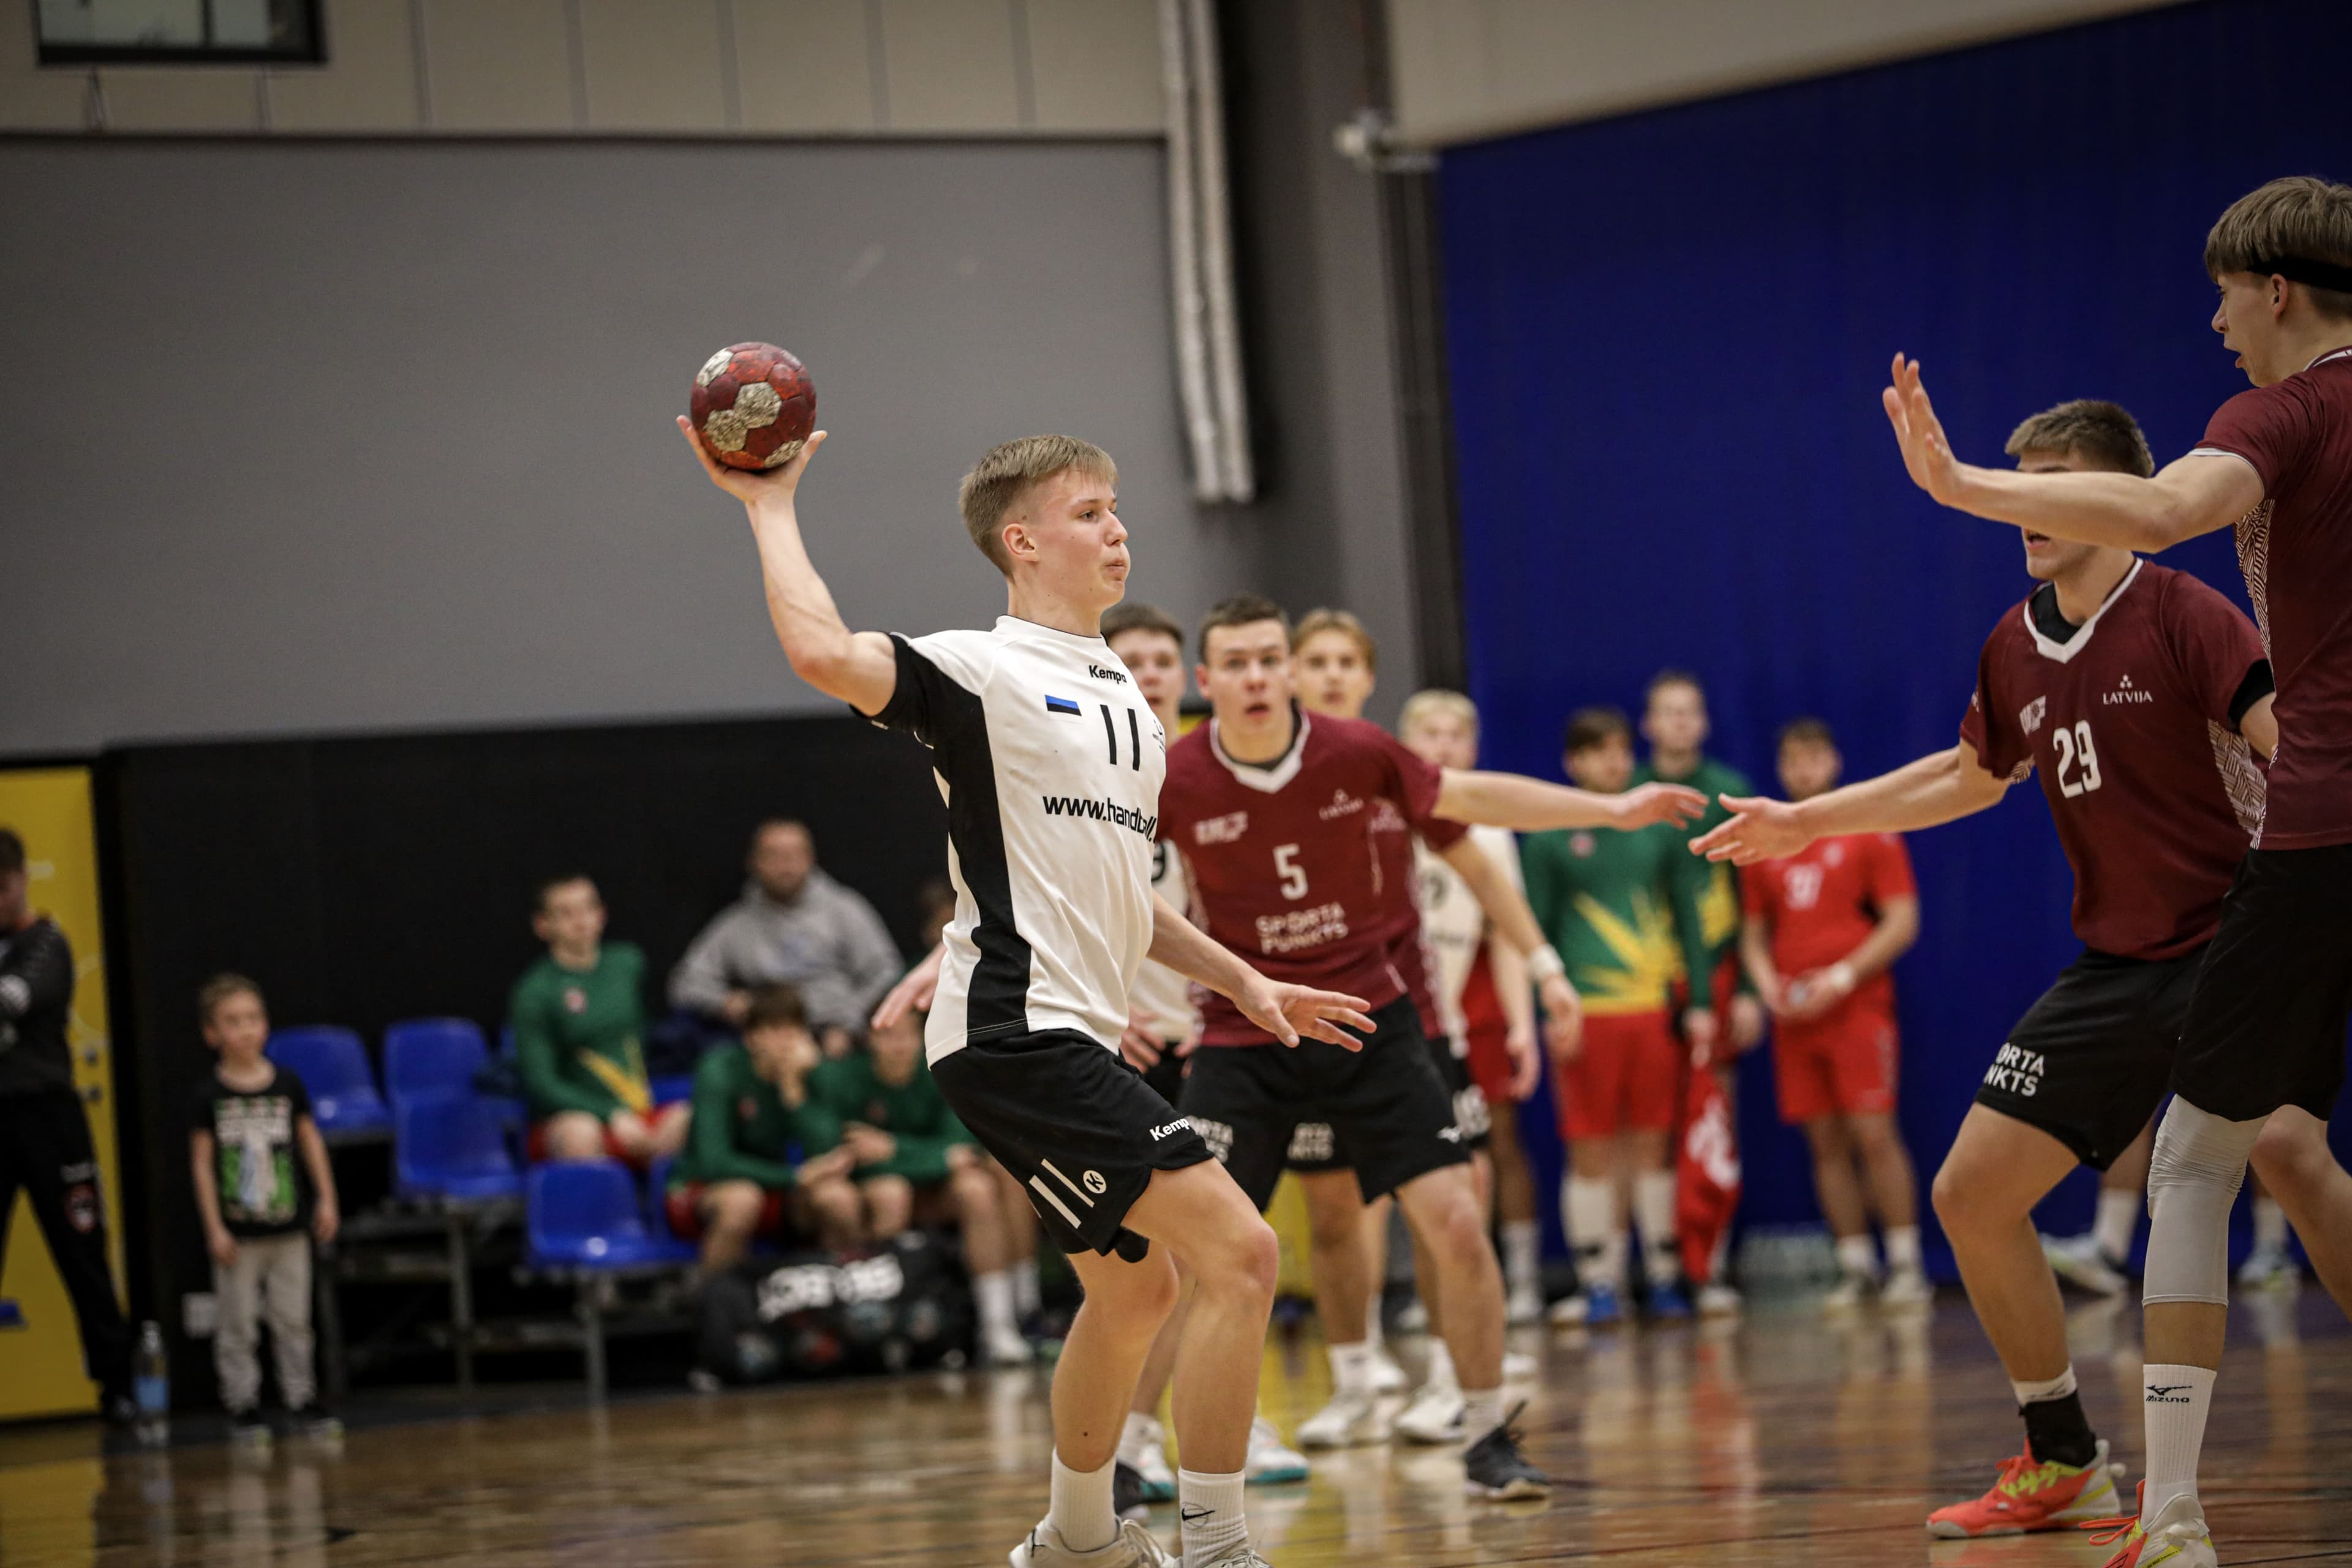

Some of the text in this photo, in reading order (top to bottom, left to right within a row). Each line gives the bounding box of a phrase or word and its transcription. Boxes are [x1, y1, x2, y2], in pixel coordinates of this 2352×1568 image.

[1088, 665, 1128, 685] Kempa
[2103, 690, 2153, 706] LATVIJA
[1100, 704, 1140, 771] 11
[2053, 720, 2102, 799] 29
[1042, 796, 1157, 844] www.handball.
[1273, 843, 1308, 900] 5
[1996, 1042, 2045, 1077] ORTA
[1150, 1118, 1189, 1140] Kemp
